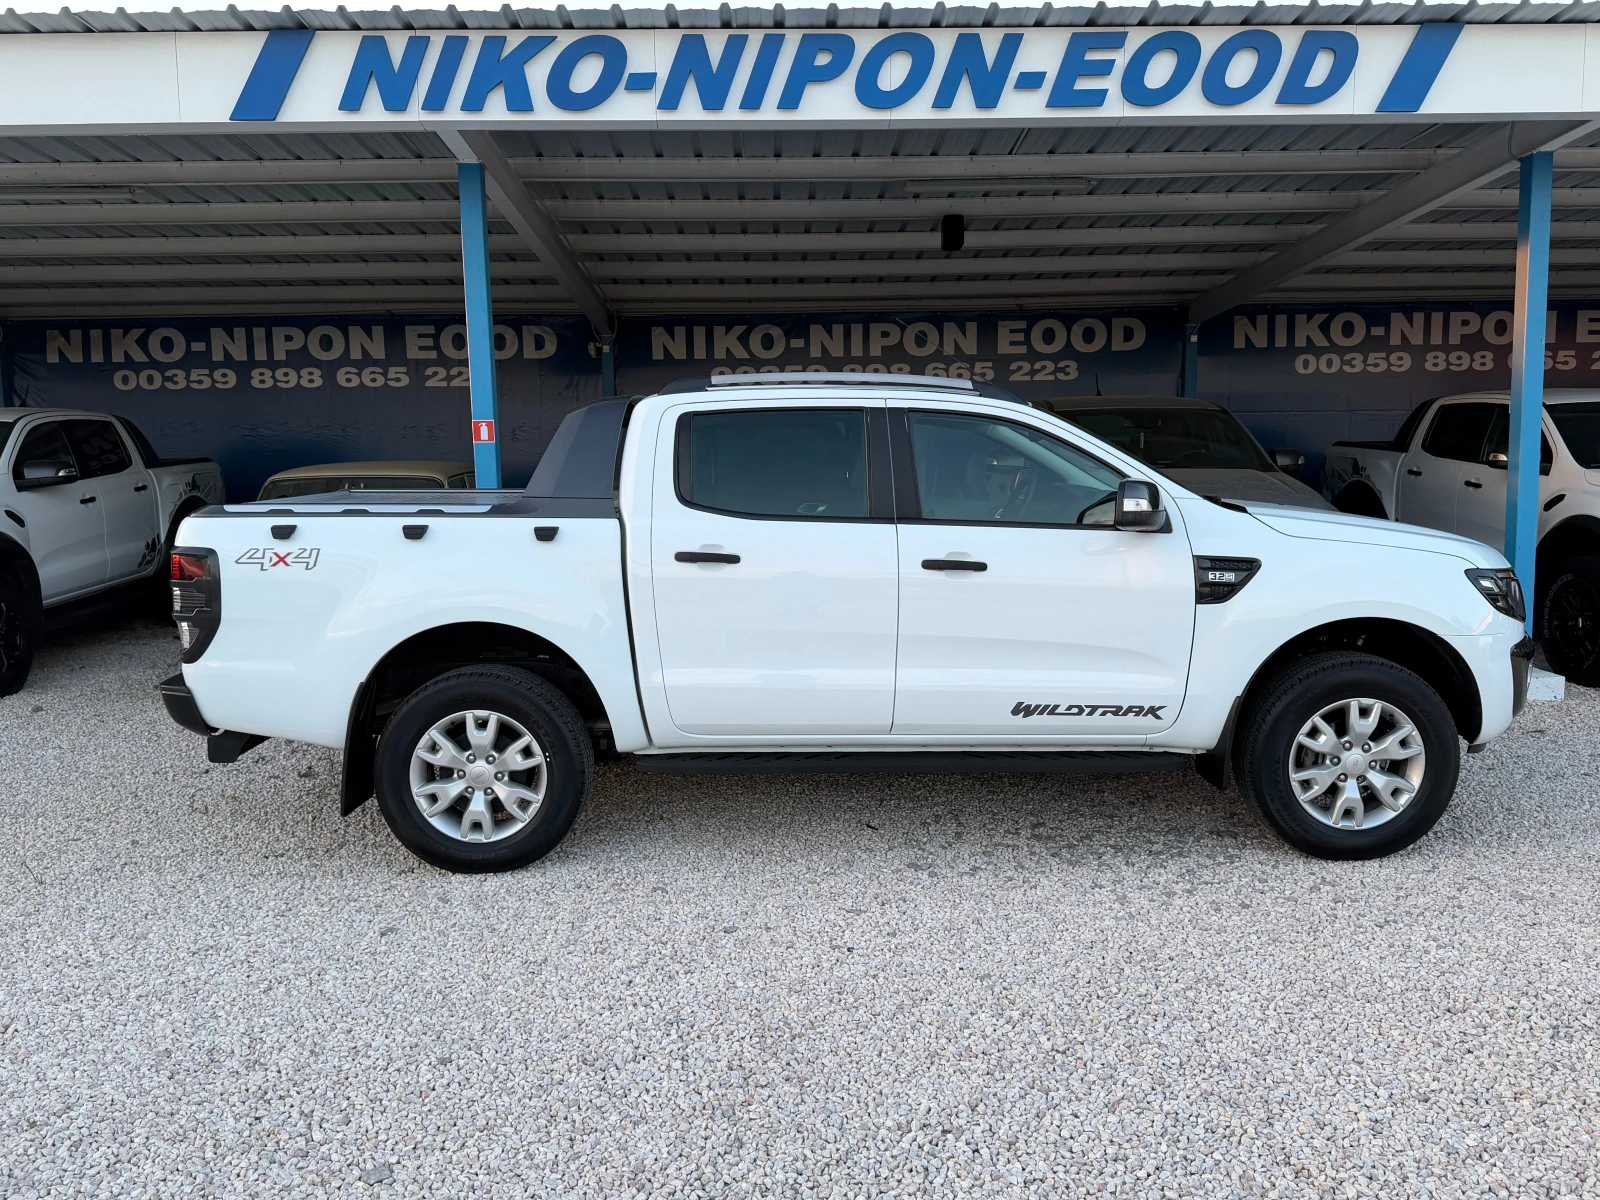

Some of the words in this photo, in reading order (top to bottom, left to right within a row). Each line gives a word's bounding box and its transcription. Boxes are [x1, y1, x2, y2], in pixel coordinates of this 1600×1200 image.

[338, 29, 1359, 112] NIKO-NIPON-EOOD
[45, 325, 386, 363] NIKO-NIPON
[404, 324, 558, 360] EOOD
[651, 321, 978, 360] NIKO-NIPON
[997, 318, 1147, 355] EOOD
[925, 361, 994, 382] 665
[1009, 359, 1079, 381] 223
[1294, 352, 1412, 375] 00359
[1424, 350, 1495, 373] 898
[113, 367, 237, 391] 00359
[250, 366, 323, 389] 898
[336, 366, 409, 389] 665
[424, 366, 470, 387] 22
[1010, 701, 1168, 720] WILDTRAK
